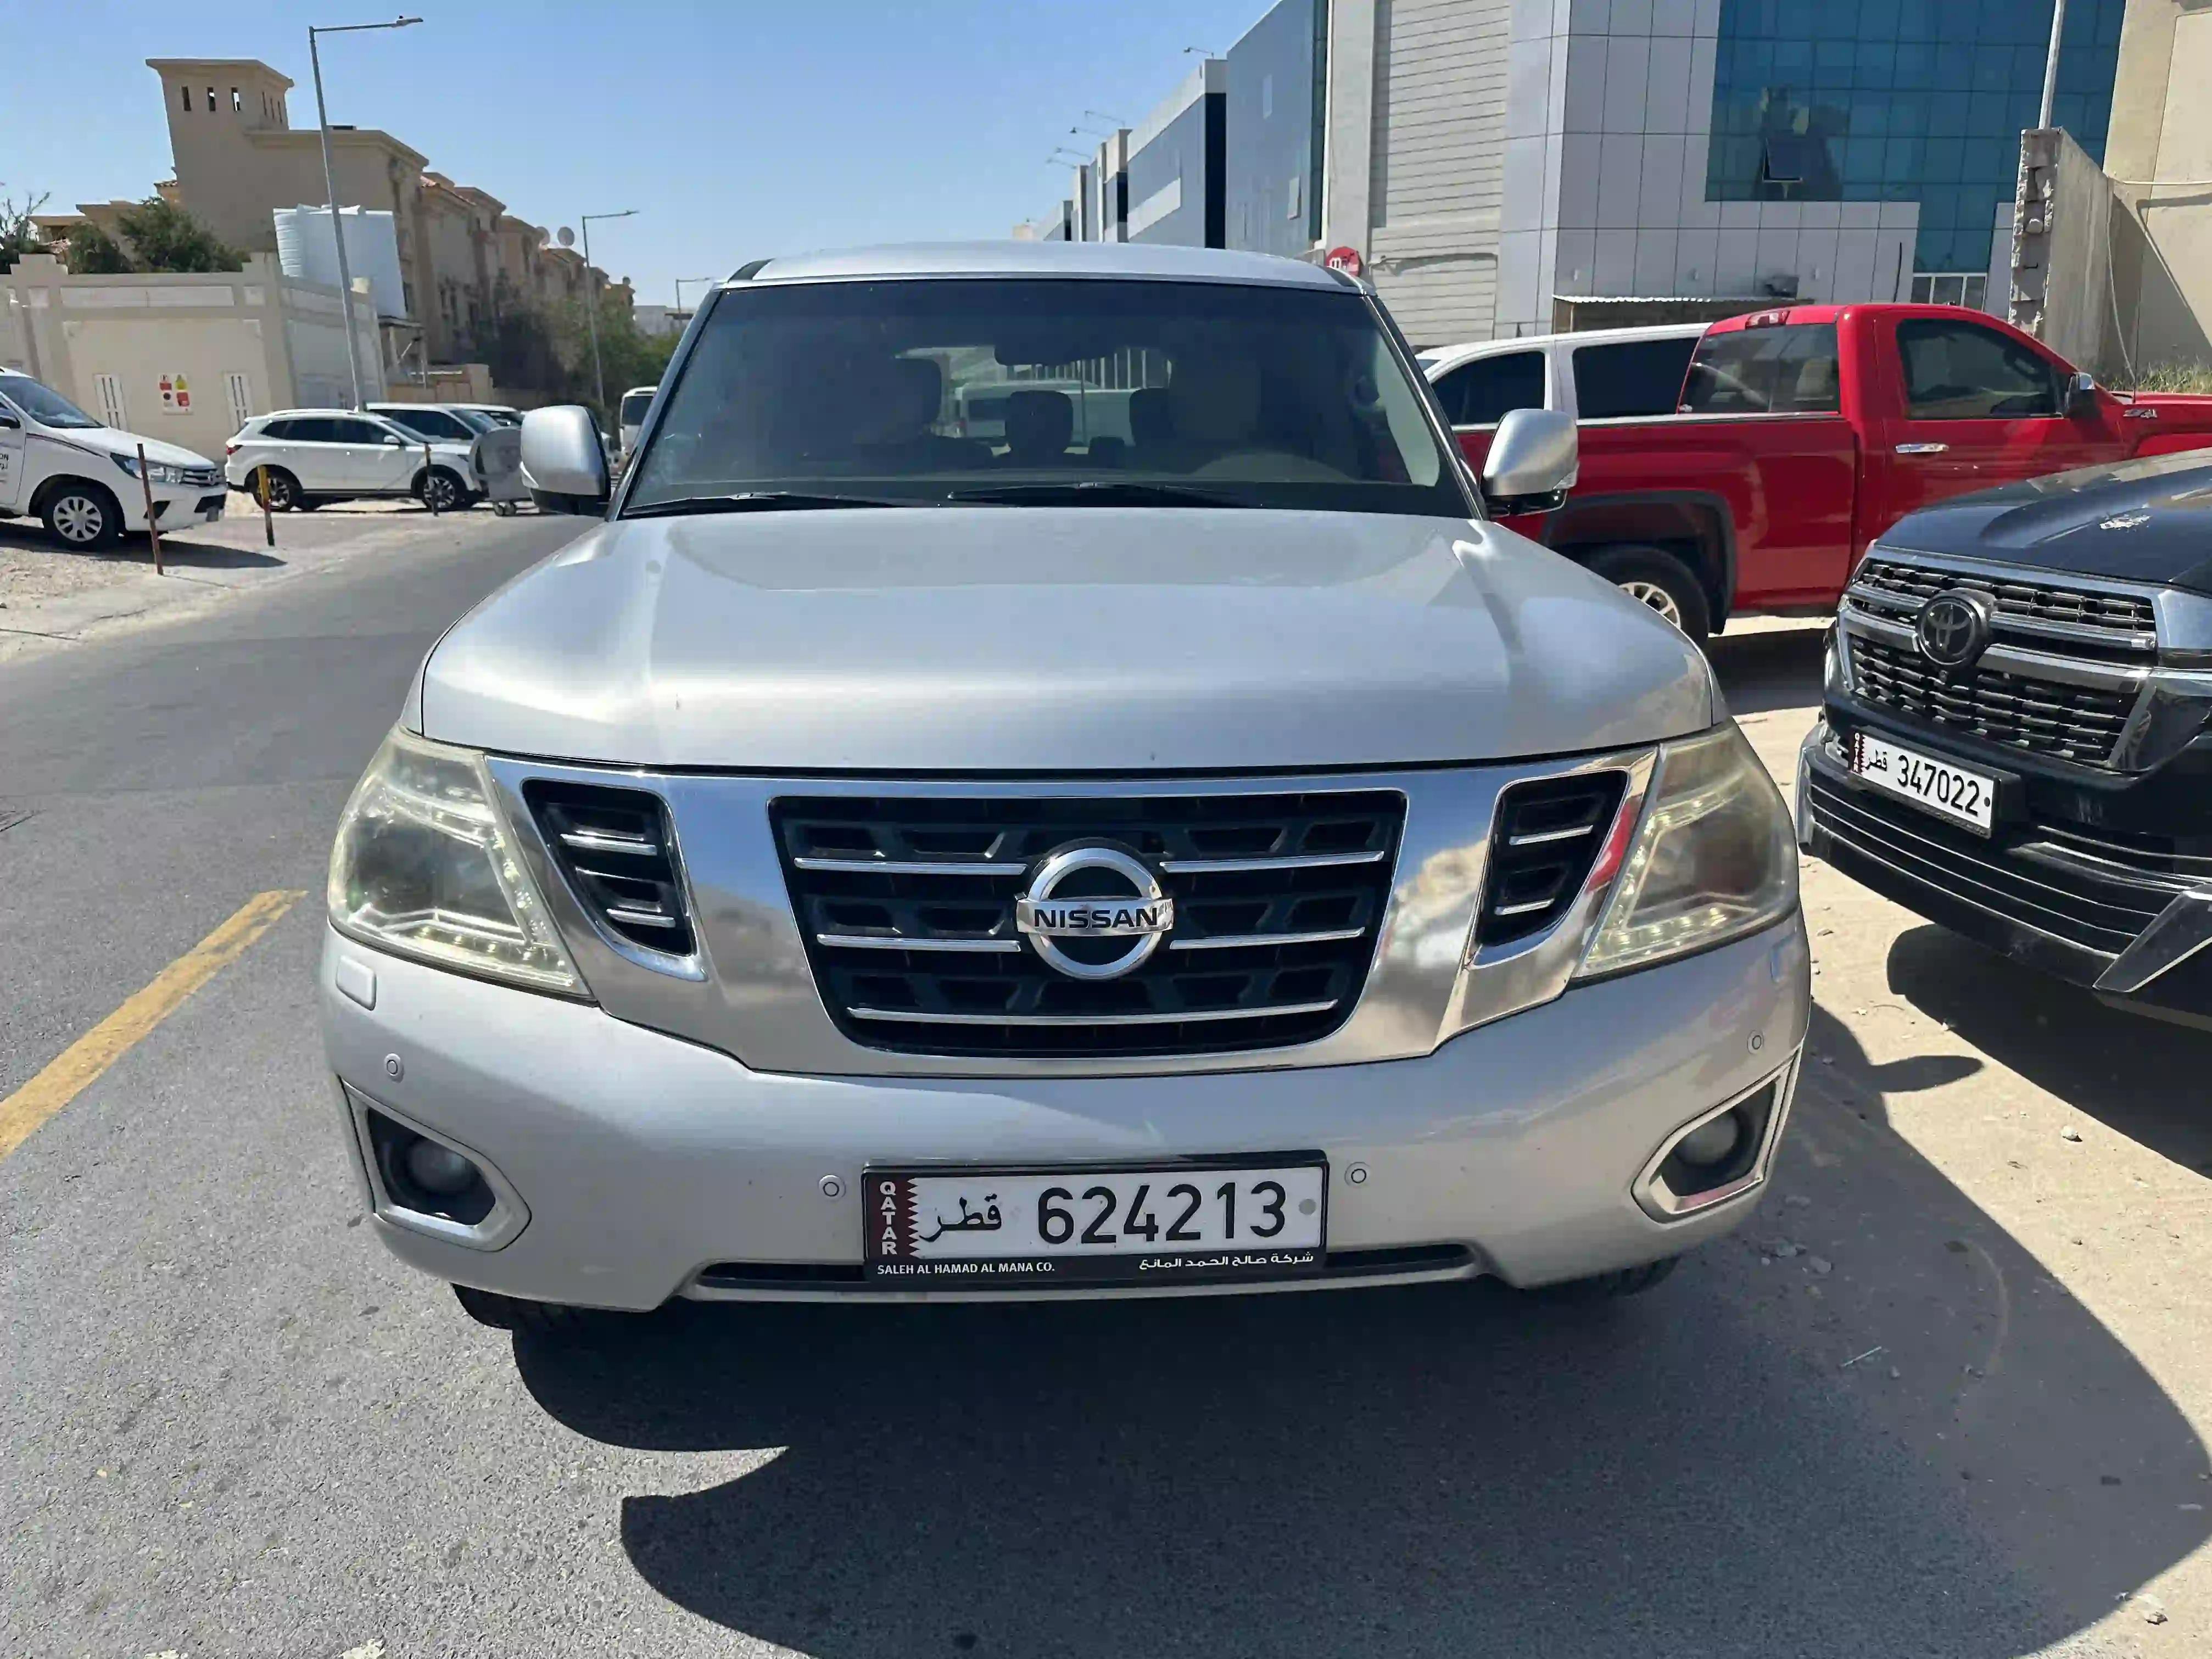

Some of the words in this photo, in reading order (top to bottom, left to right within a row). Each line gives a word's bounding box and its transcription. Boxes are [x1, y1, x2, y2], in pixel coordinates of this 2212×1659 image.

[1864, 748, 1887, 772] قطر
[1897, 754, 1980, 818] 347022
[1034, 907, 1157, 929] NISSAN
[880, 1181, 898, 1255] QATAR
[919, 1193, 1002, 1243] قطر
[1037, 1180, 1287, 1245] 624213
[877, 1264, 914, 1275] SALEH
[917, 1264, 932, 1274] AL
[934, 1264, 978, 1273] HAMAD
[980, 1263, 996, 1273] AL
[998, 1263, 1034, 1273] MANA
[1036, 1261, 1055, 1272] CO.
[1138, 1258, 1182, 1270] المانع
[1185, 1255, 1228, 1267] الحمد
[1232, 1254, 1267, 1267] صالح
[1270, 1251, 1314, 1265] شركة
